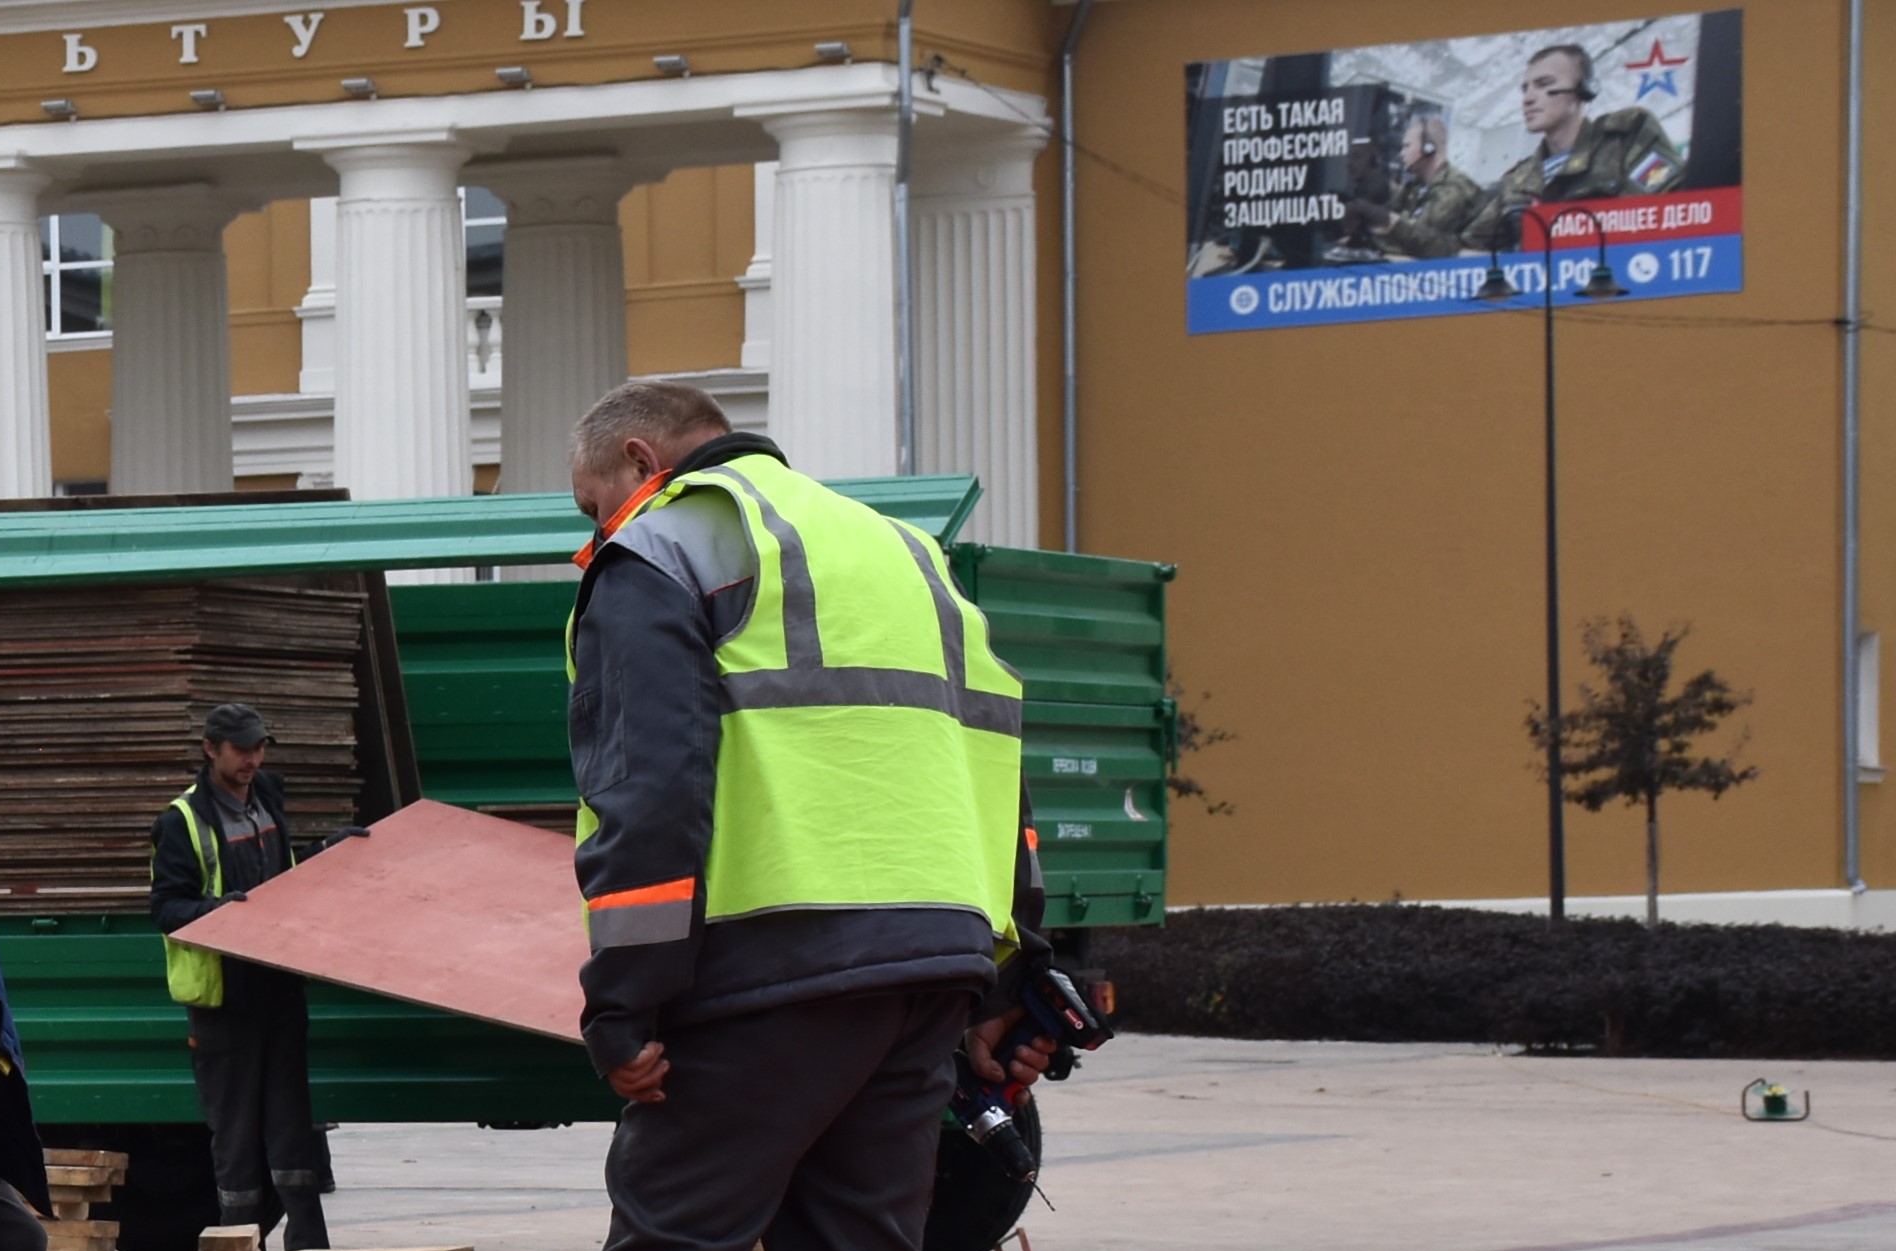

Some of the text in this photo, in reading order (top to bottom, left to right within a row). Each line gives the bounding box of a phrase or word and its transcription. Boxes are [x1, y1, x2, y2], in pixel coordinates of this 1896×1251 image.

[1223, 98, 1344, 133] ЕСТЬ ТАКАЯ
[1223, 129, 1348, 165] ПРОФЕССИЯ
[1224, 165, 1308, 197] РОДИНУ
[1224, 194, 1345, 228] ЗАЩИЩАТЬ
[1661, 201, 1712, 230] ДЕЛО
[1669, 246, 1712, 280] 117
[1268, 258, 1597, 313] СЛУЖБАПОКОНТРКТУ.РФ
